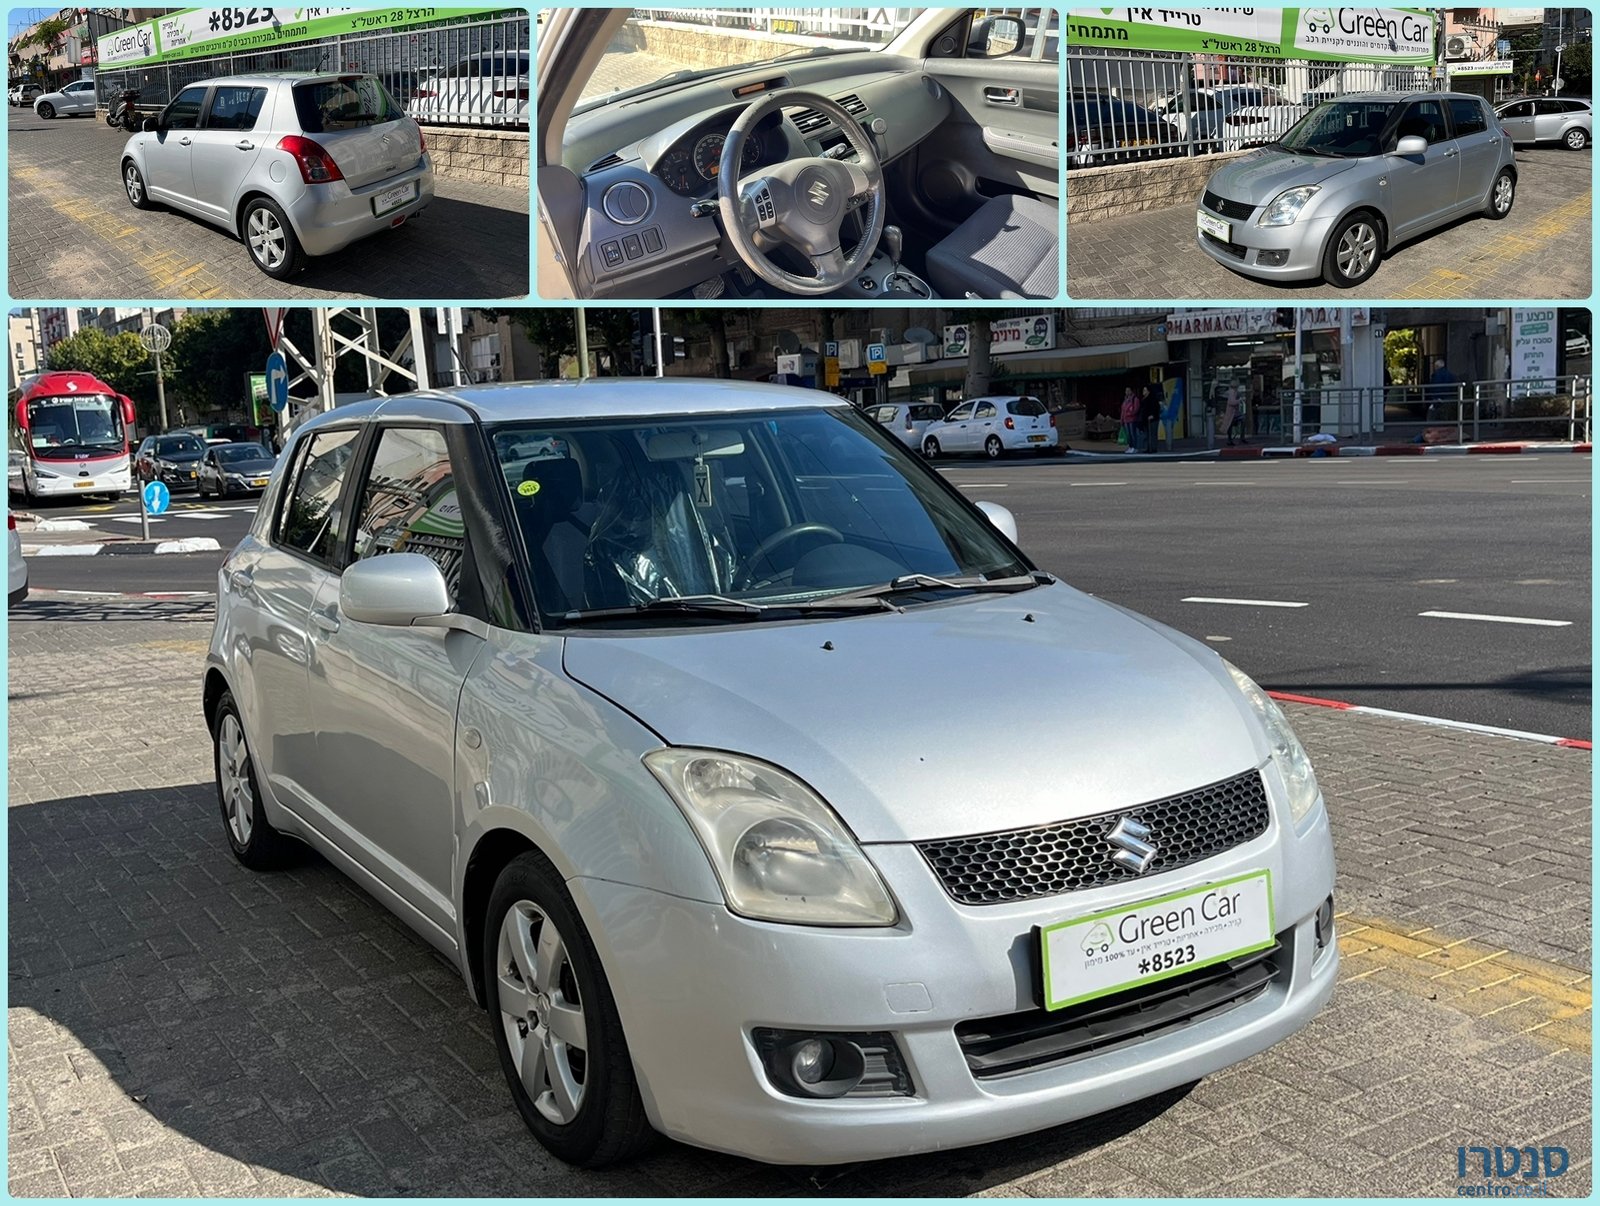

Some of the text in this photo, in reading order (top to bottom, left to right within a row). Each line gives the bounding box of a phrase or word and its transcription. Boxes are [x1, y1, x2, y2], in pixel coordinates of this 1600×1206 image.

[390, 10, 404, 22] 28
[406, 8, 435, 19] הרצל
[1158, 9, 1201, 26] טרייד
[1338, 8, 1428, 43] Green Car
[252, 32, 276, 44] במכירת
[277, 26, 308, 39] מתמחים
[1067, 24, 1129, 41] מתמחי
[114, 36, 136, 53] Green
[136, 29, 152, 48] Car
[1305, 35, 1319, 43] רכב
[1321, 36, 1345, 47] לקניית
[1244, 42, 1257, 53] 28
[1259, 43, 1281, 54] הרצל
[1526, 311, 1554, 322] מבצע
[1166, 314, 1242, 336] PHARMACY
[1118, 892, 1241, 944] Green Car
[1204, 924, 1224, 935] מכירה
[1176, 930, 1200, 944] אחריות
[1126, 948, 1136, 957] עד
[1140, 943, 1152, 955] אין
[1105, 950, 1126, 963] 100%
[1084, 957, 1104, 970] מימון
